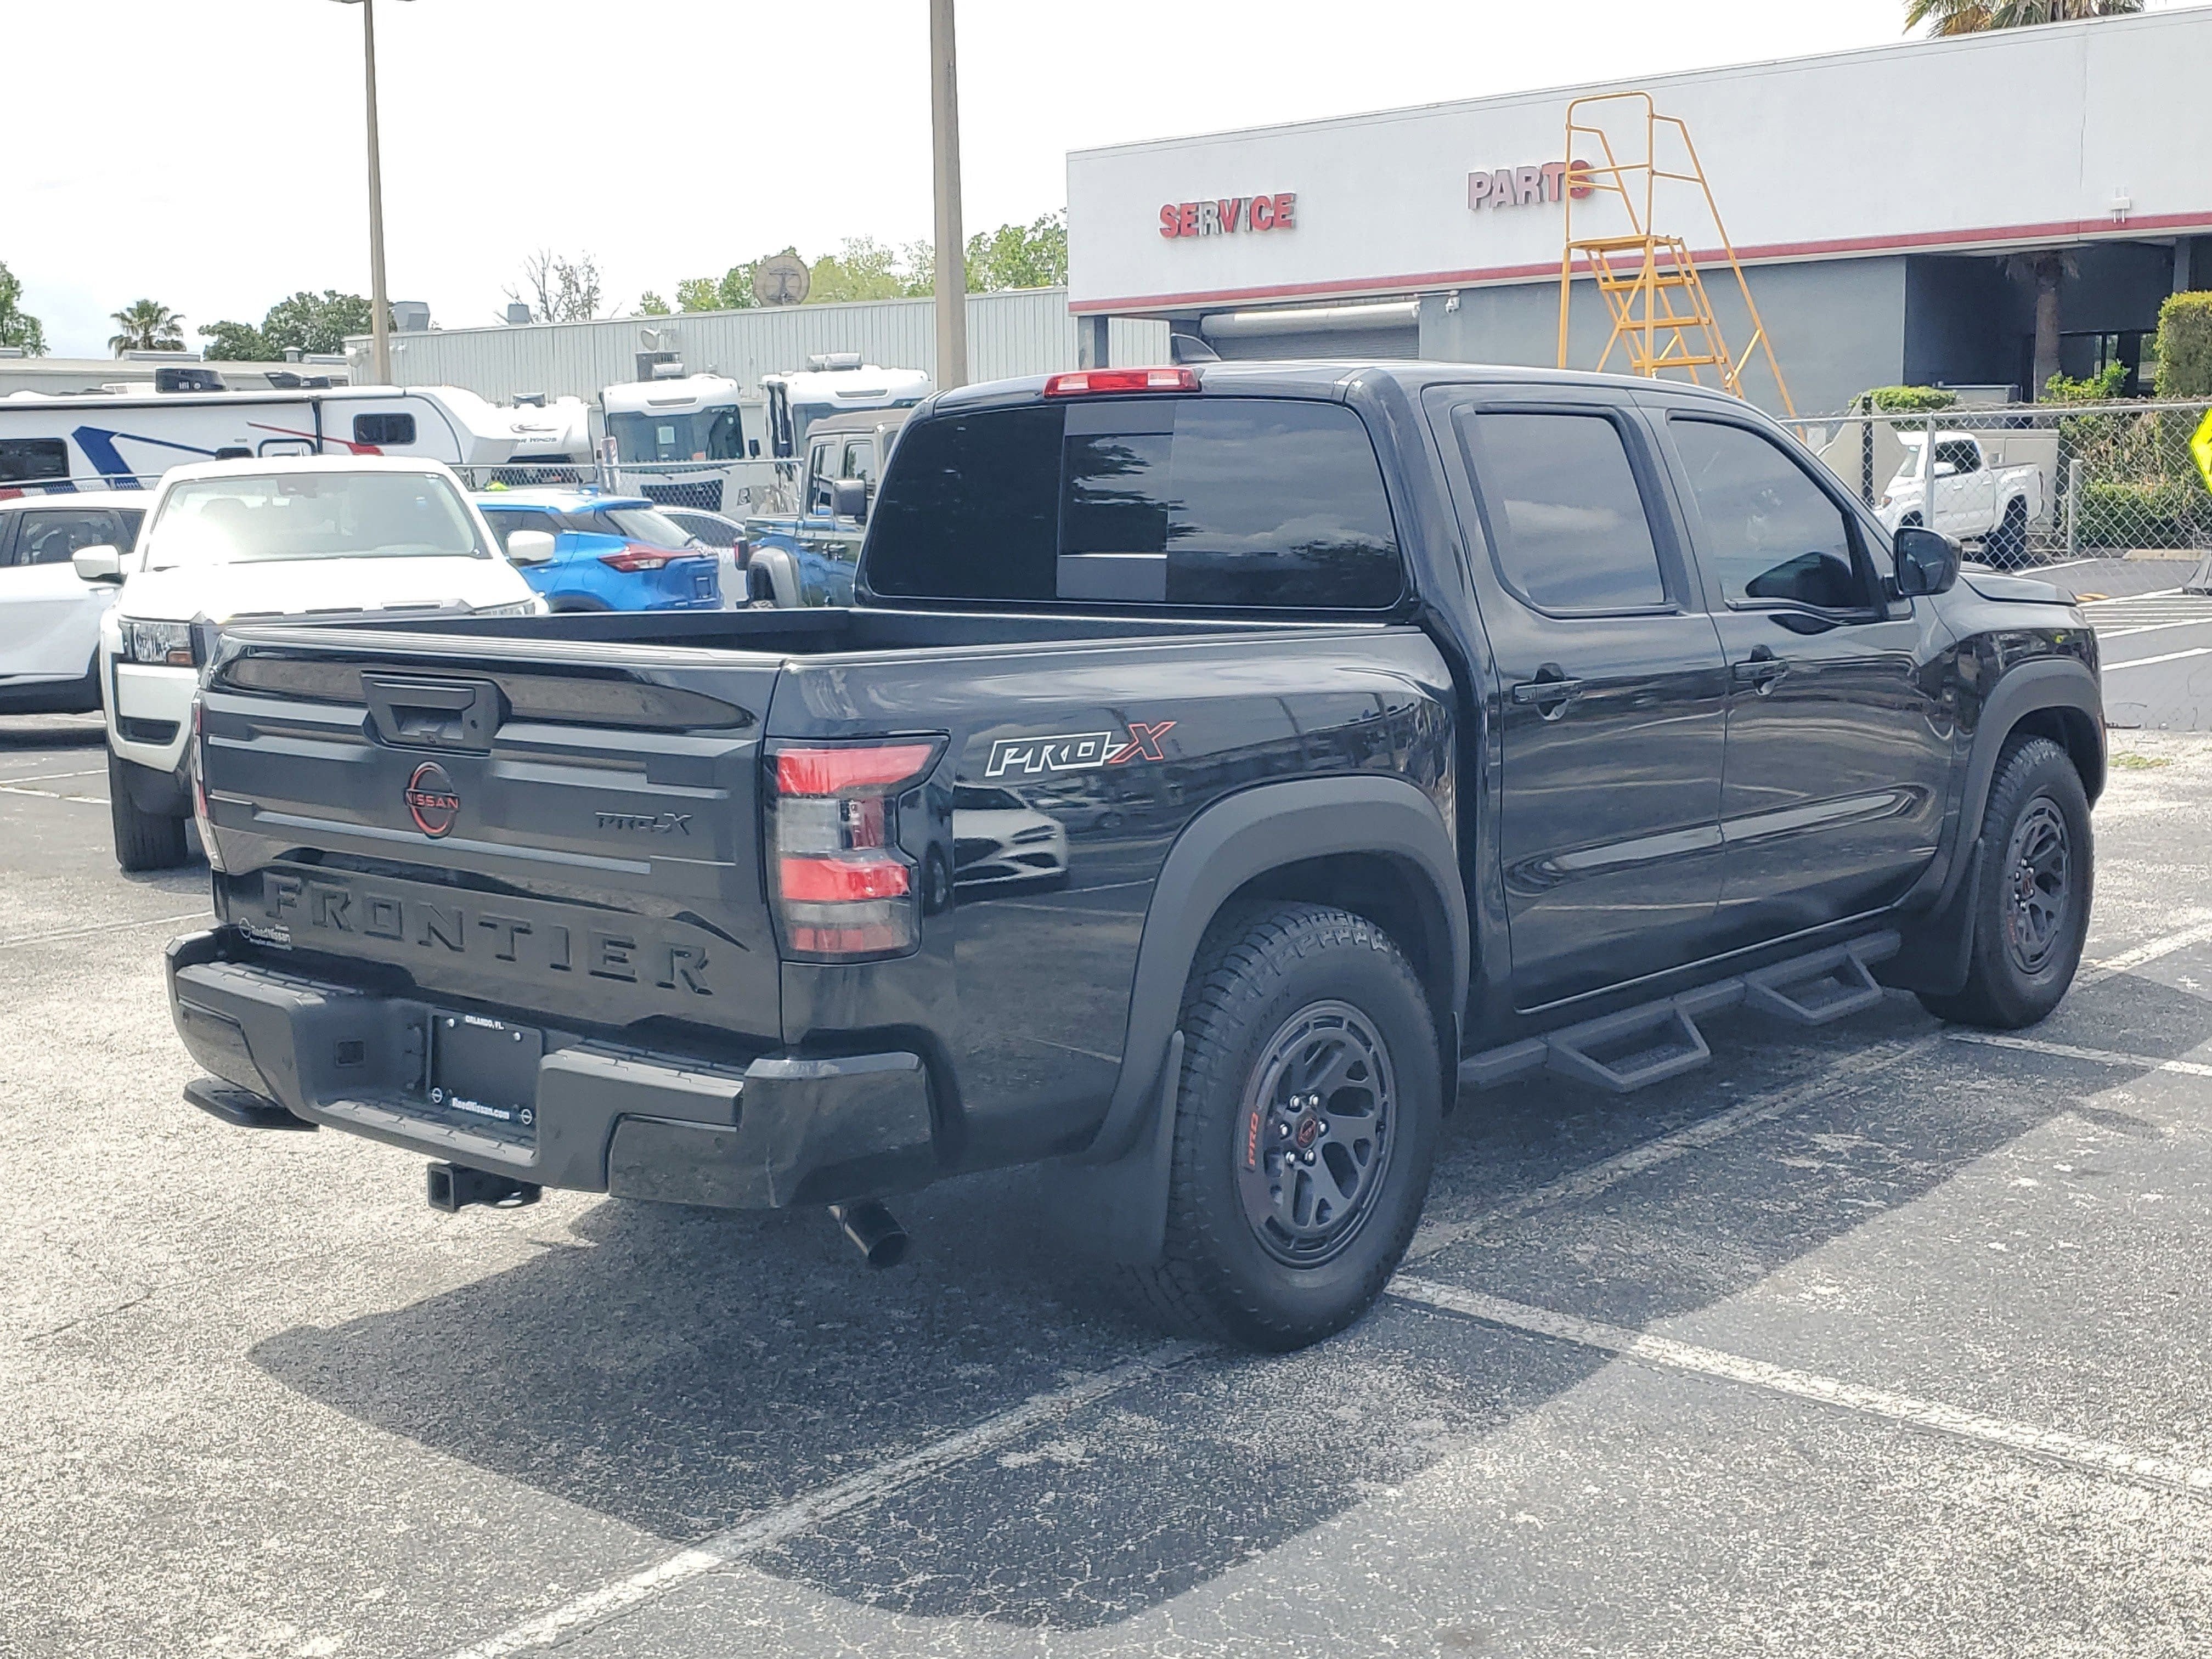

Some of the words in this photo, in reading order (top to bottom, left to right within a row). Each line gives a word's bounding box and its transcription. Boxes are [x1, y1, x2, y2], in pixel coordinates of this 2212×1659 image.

[1467, 159, 1594, 210] PARTS
[1159, 192, 1296, 238] SERVICE
[406, 791, 459, 809] NISSAN
[262, 871, 714, 995] FRONTIER
